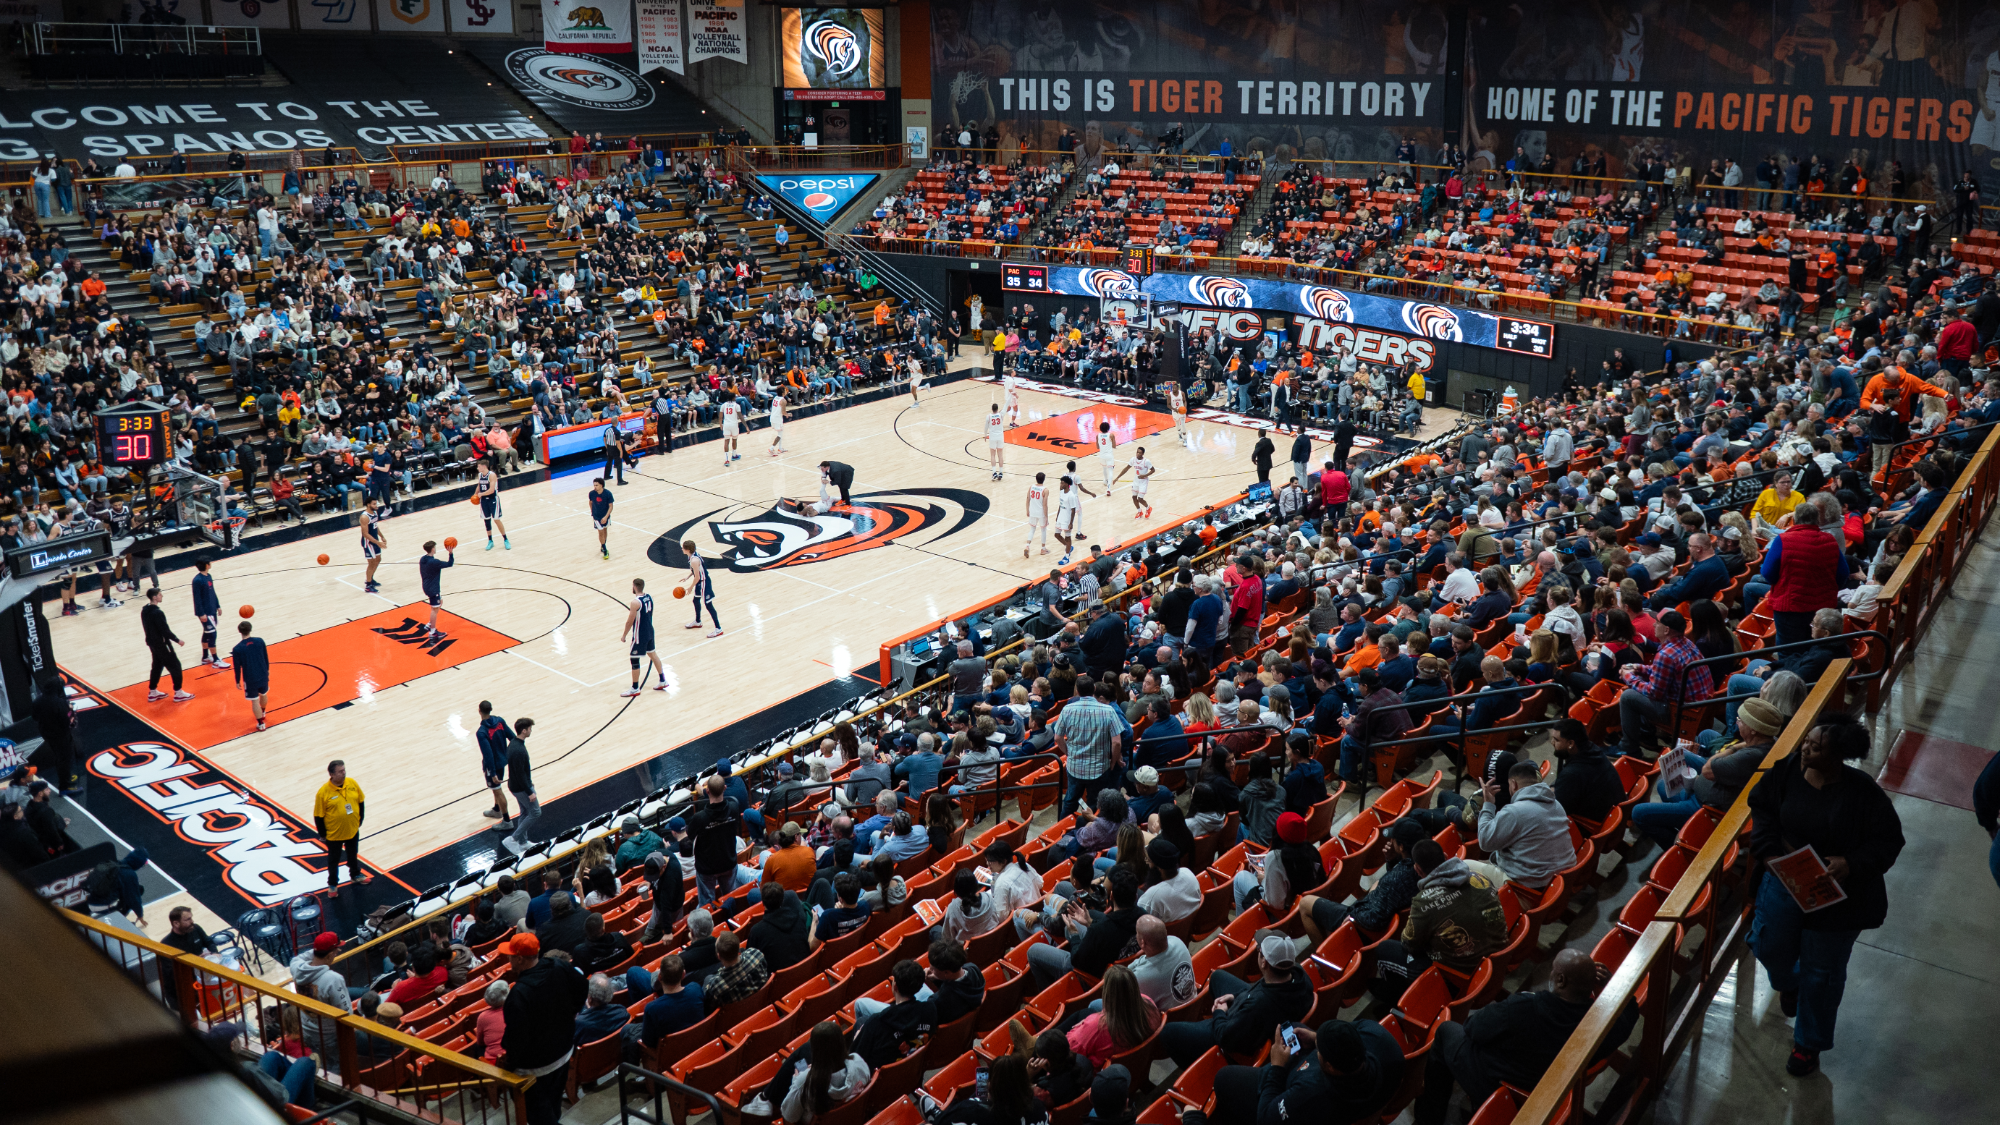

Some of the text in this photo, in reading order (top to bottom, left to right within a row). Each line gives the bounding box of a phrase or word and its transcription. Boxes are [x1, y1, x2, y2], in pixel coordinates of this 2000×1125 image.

[695, 11, 738, 20] PACIFIC
[692, 33, 741, 41] VOLLEYBALL
[1000, 78, 1432, 117] THIS IS TIGER TERRITORY
[236, 102, 318, 121] TO
[326, 100, 440, 118] THE
[1486, 86, 1974, 143] HOME OF THE PACIFIC TIGERS
[82, 128, 336, 156] SPANOS
[356, 122, 549, 144] CENTER
[15, 188, 22, 196] S
[779, 176, 855, 193] pepsi
[1130, 249, 1143, 258] 3:33
[1127, 258, 1142, 274] 30
[1007, 277, 1042, 288] 35 34
[1510, 321, 1540, 336] 3:34
[1293, 314, 1435, 372] TIGERS
[1503, 333, 1547, 346] HALF SHOT
[1533, 345, 1544, 354] 30
[119, 416, 153, 431] 3:33
[991, 417, 1001, 426] 33
[117, 434, 151, 461] 30
[163, 425, 173, 459] ADART
[1030, 490, 1041, 500] 30
[68, 548, 93, 559] Center
[23, 602, 43, 672] TicketSmarter
[86, 741, 374, 908] PACIFIC
[1420, 899, 1440, 912] LAKE
[1441, 890, 1462, 903] POINT
